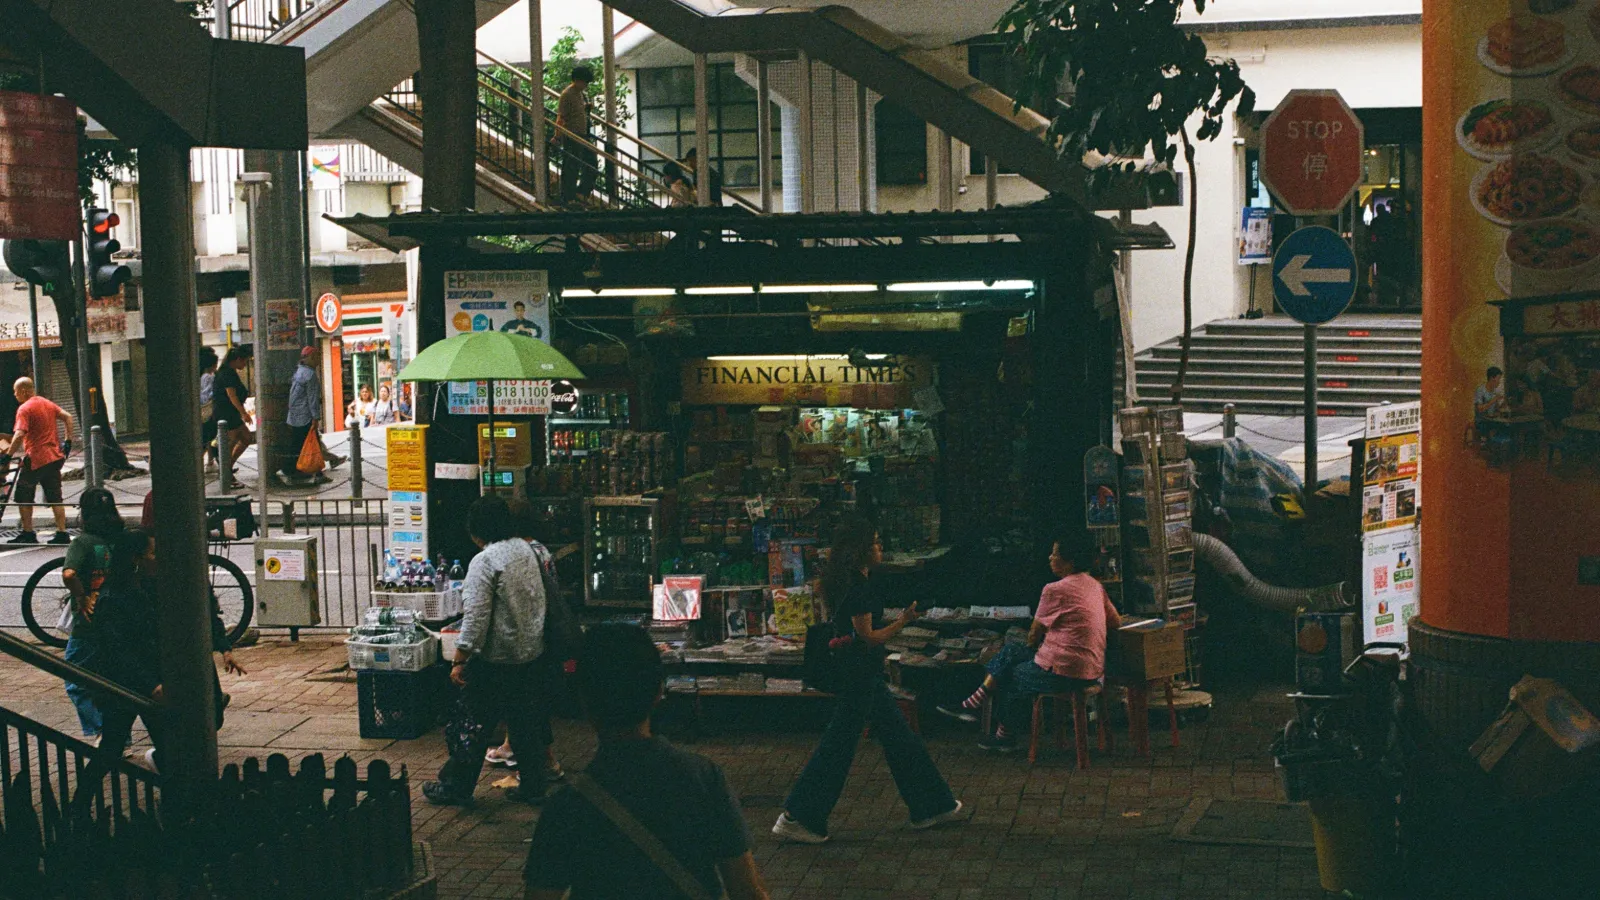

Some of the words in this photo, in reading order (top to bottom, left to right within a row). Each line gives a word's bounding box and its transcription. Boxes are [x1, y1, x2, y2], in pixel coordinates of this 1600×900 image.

[1288, 121, 1343, 139] STOP
[1302, 151, 1329, 180] 停
[697, 365, 833, 384] FINANCIAL
[839, 364, 916, 384] TIMES
